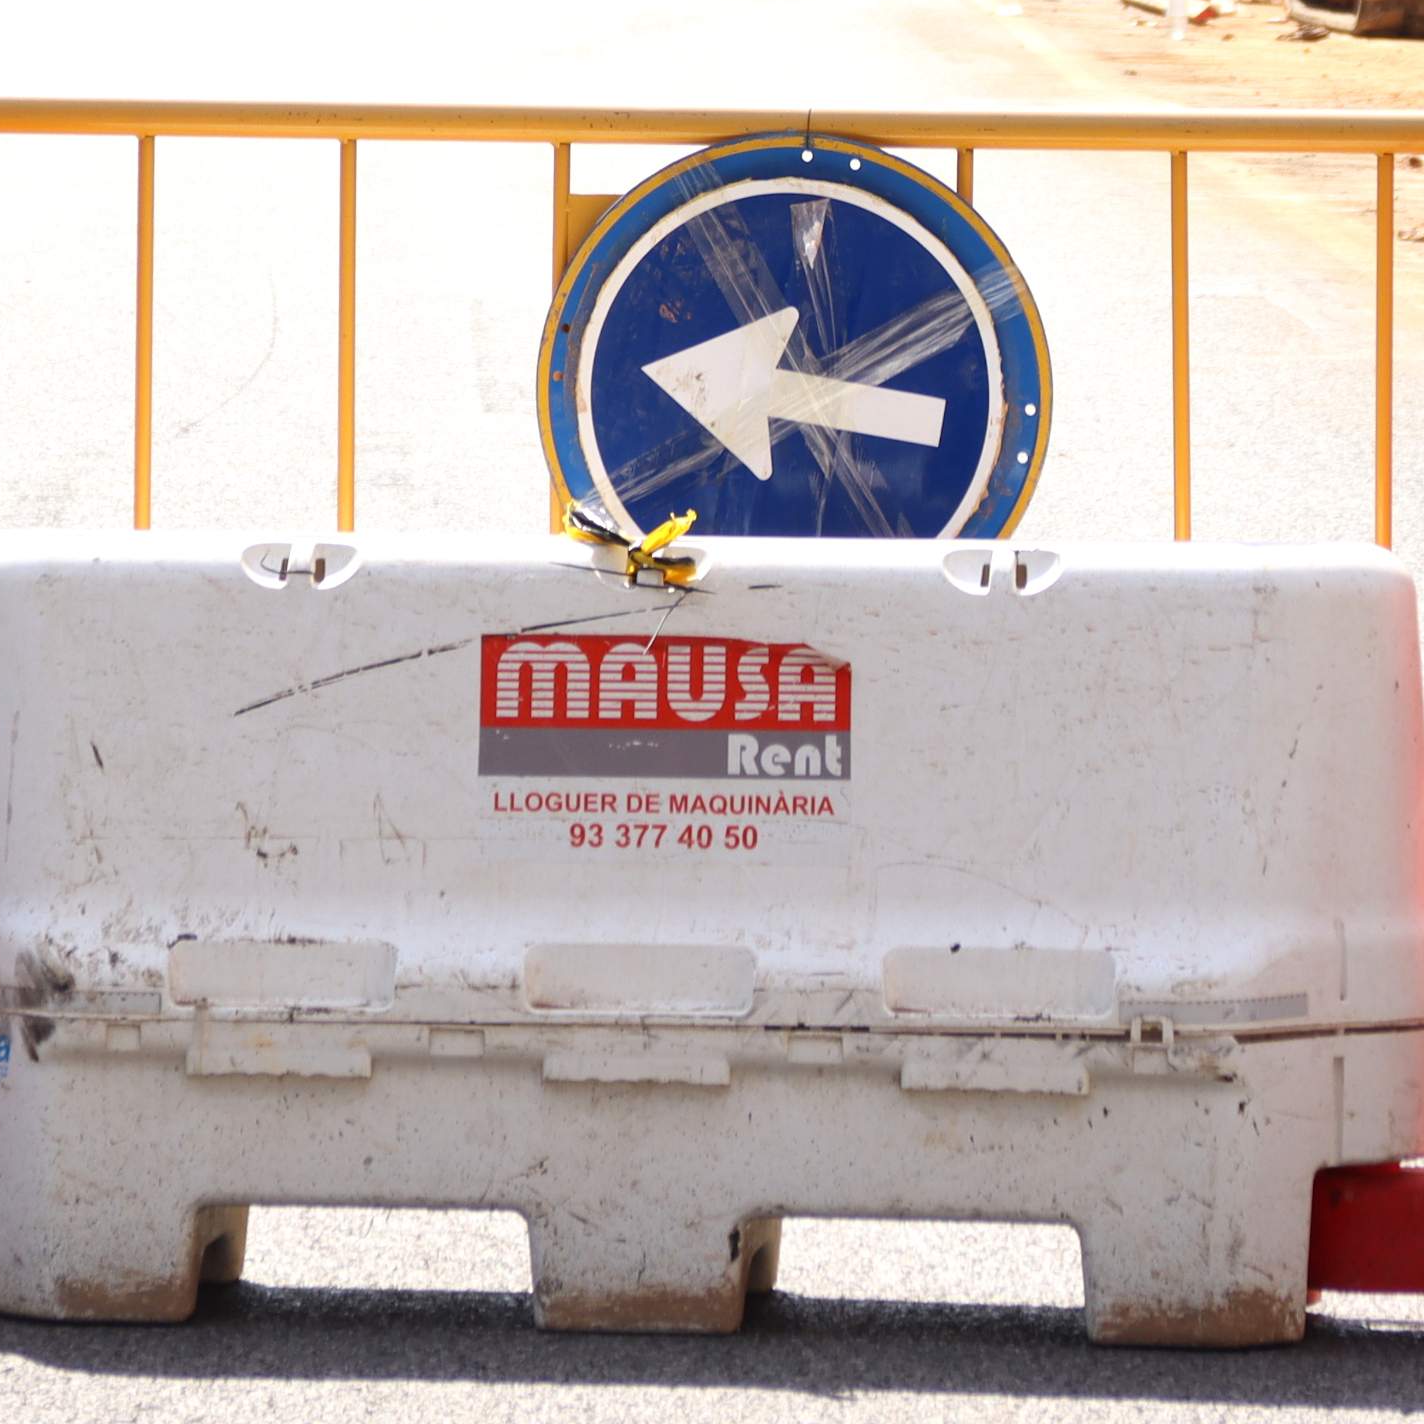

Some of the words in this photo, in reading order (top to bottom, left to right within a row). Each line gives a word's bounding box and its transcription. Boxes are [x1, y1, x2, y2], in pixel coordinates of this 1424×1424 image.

[727, 733, 842, 777] Rent
[494, 791, 618, 814] LLOGUER
[626, 793, 660, 814] DE
[669, 790, 835, 816] MAQUINÀRIA
[569, 823, 604, 849] 93
[615, 824, 667, 849] 377
[678, 825, 713, 850] 40
[724, 825, 759, 851] 50
